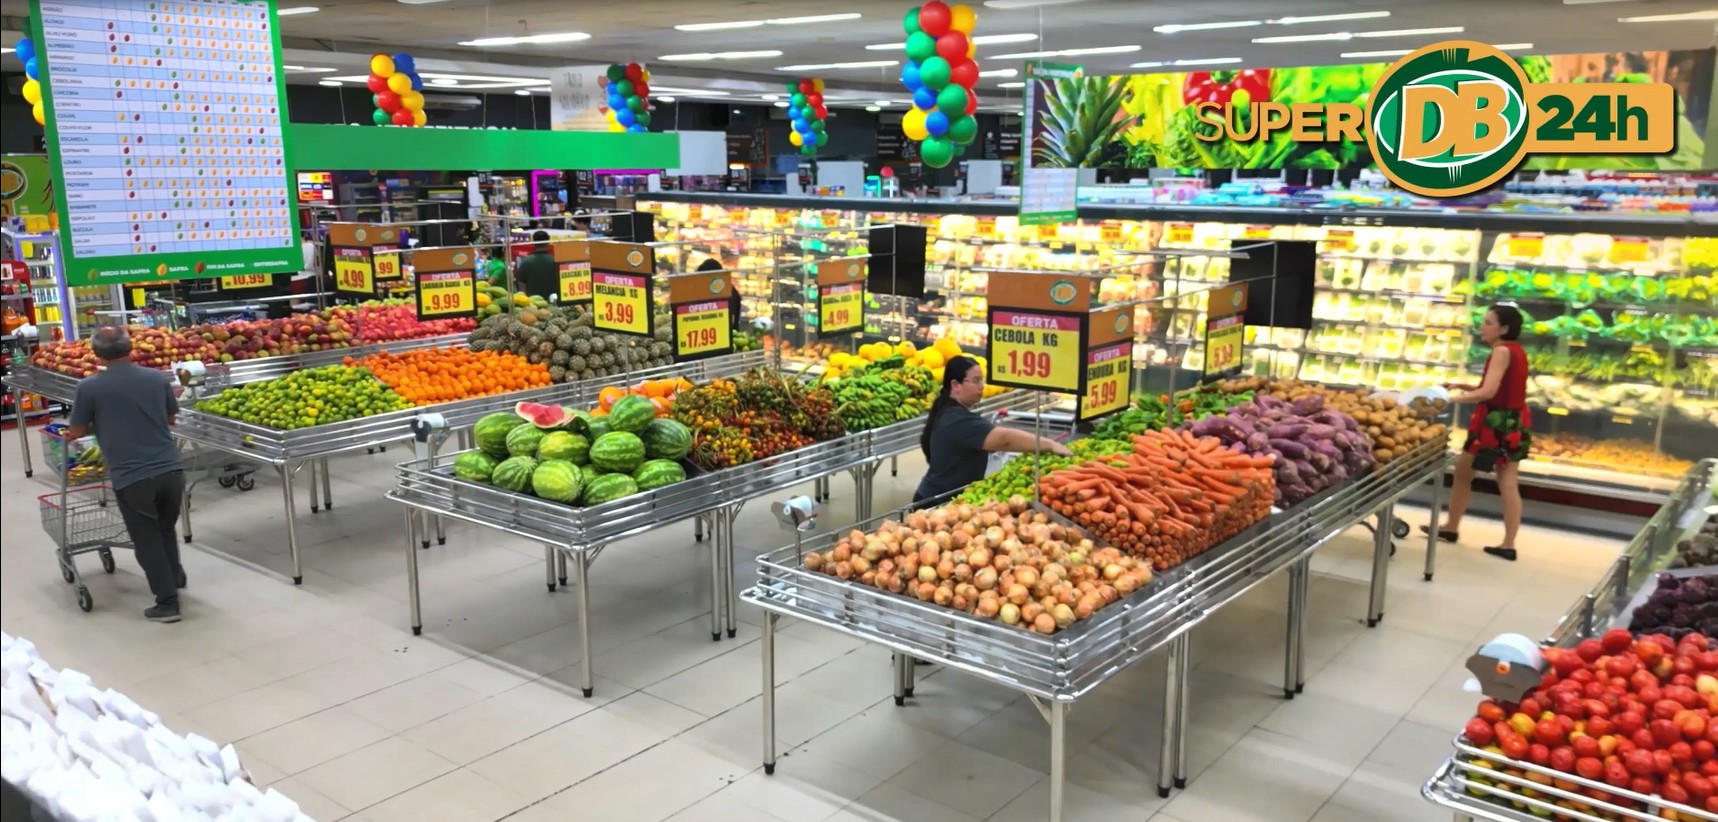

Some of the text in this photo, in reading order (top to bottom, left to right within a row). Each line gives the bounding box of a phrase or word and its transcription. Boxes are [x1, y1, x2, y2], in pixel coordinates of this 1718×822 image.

[431, 272, 460, 280] OFERTA
[604, 275, 634, 286] OFERTA
[568, 281, 592, 297] 8,99
[595, 284, 639, 299] MELANCIA KG
[432, 293, 460, 311] 9,99
[688, 301, 718, 313] OFERTA
[605, 301, 634, 325] 3,99
[1011, 315, 1059, 329] OFERTA
[686, 327, 717, 349] 17,99
[994, 328, 1059, 347] CEBOLA KG
[1008, 349, 1051, 379] 1,99
[1094, 348, 1120, 363] OFERTA
[1087, 360, 1127, 381] ENOURA KG
[1091, 379, 1117, 409] 5,99
